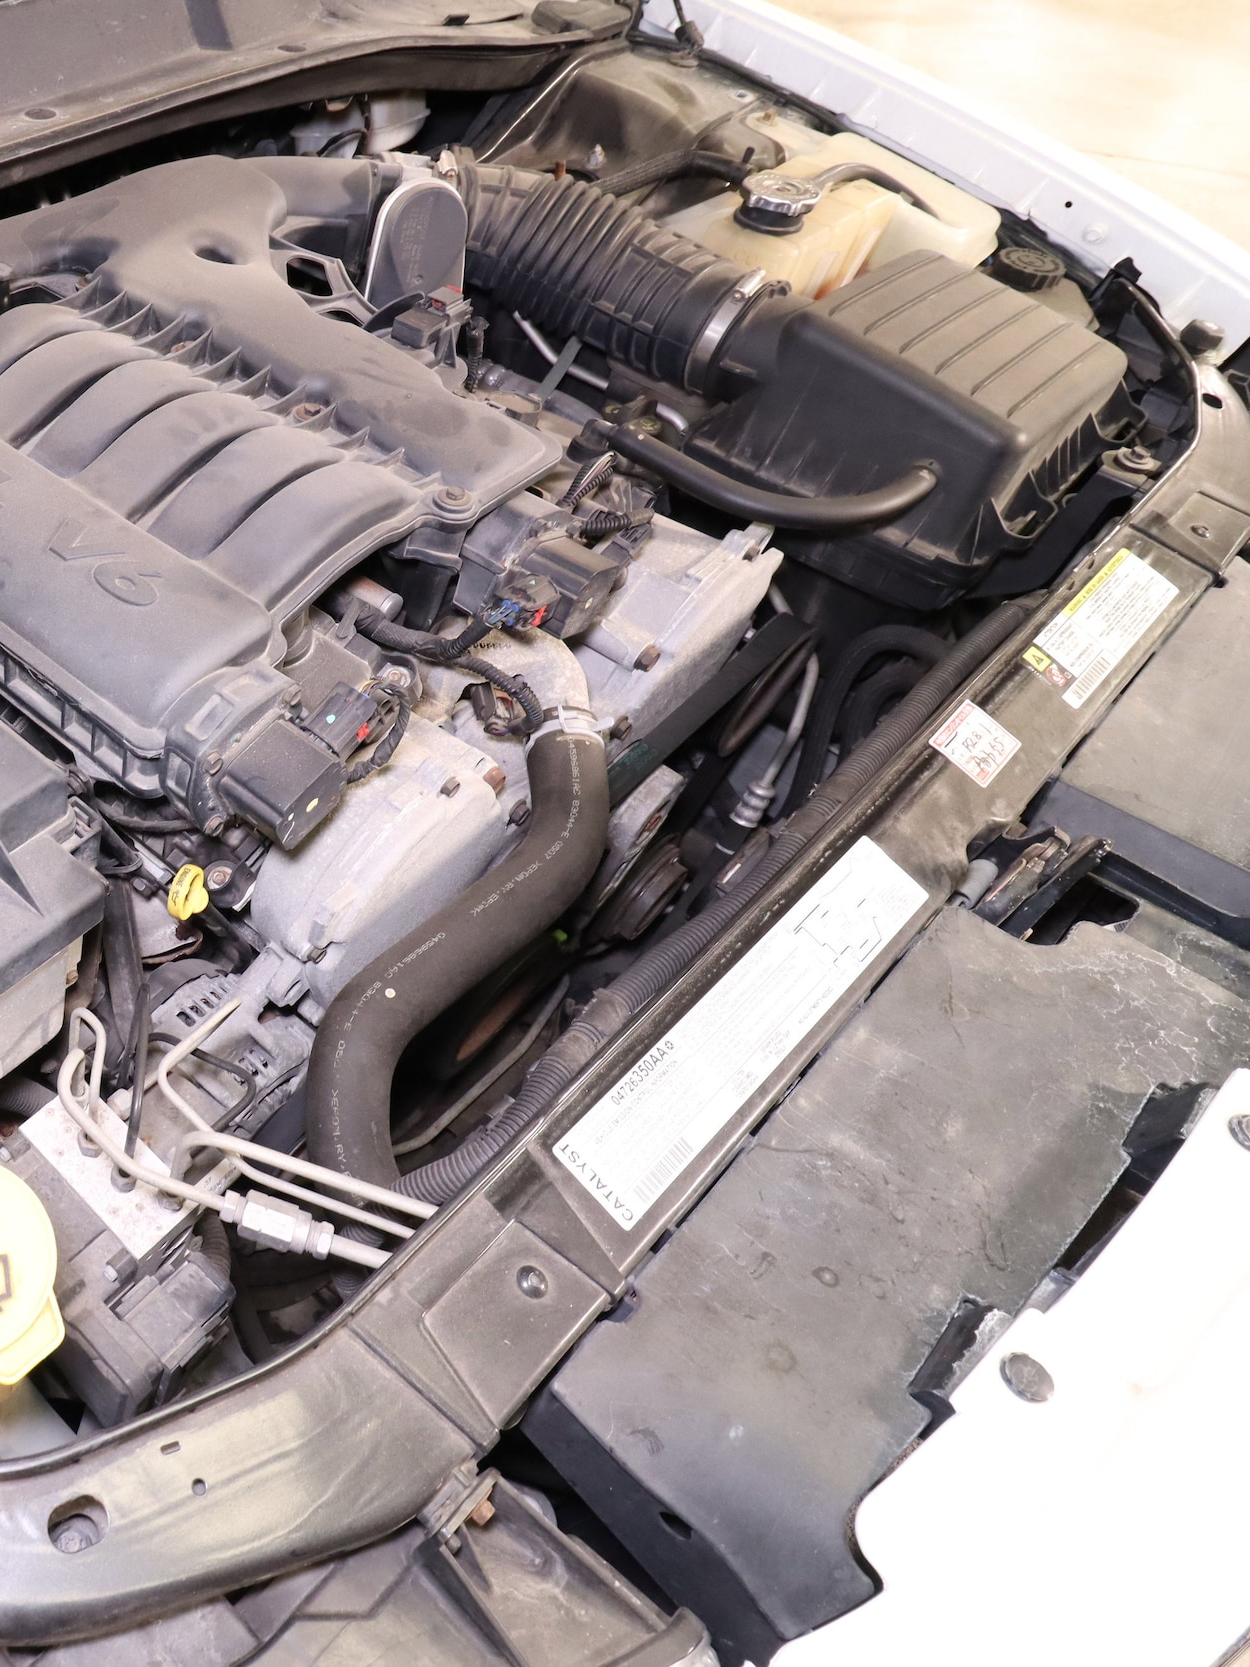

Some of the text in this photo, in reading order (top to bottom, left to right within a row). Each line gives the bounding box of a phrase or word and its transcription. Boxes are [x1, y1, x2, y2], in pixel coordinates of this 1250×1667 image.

[49, 517, 162, 606] V6
[611, 1047, 669, 1106] 04726350AA
[558, 1144, 634, 1221] CATALYST
